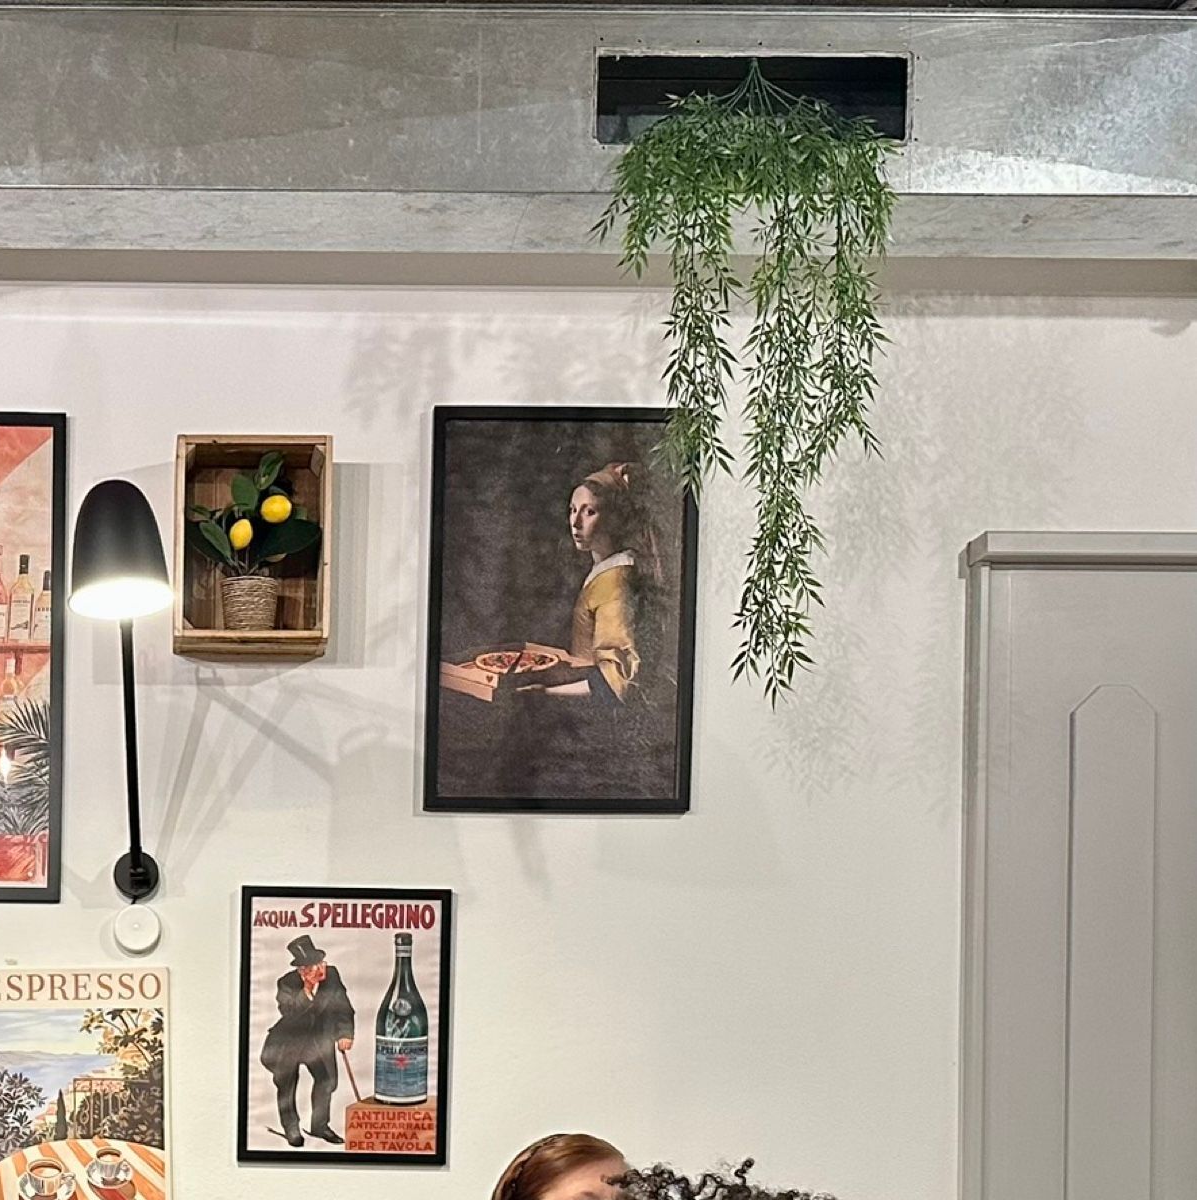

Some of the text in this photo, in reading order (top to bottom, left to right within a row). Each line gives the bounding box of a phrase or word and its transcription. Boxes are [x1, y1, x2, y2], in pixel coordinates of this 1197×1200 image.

[253, 910, 298, 928] ACQUA
[350, 1111, 433, 1121] ANTIURICA
[348, 1122, 434, 1130] ANTICATARRALE
[364, 1131, 420, 1140] OTTIMA
[349, 1141, 433, 1151] PER TAVOLA
